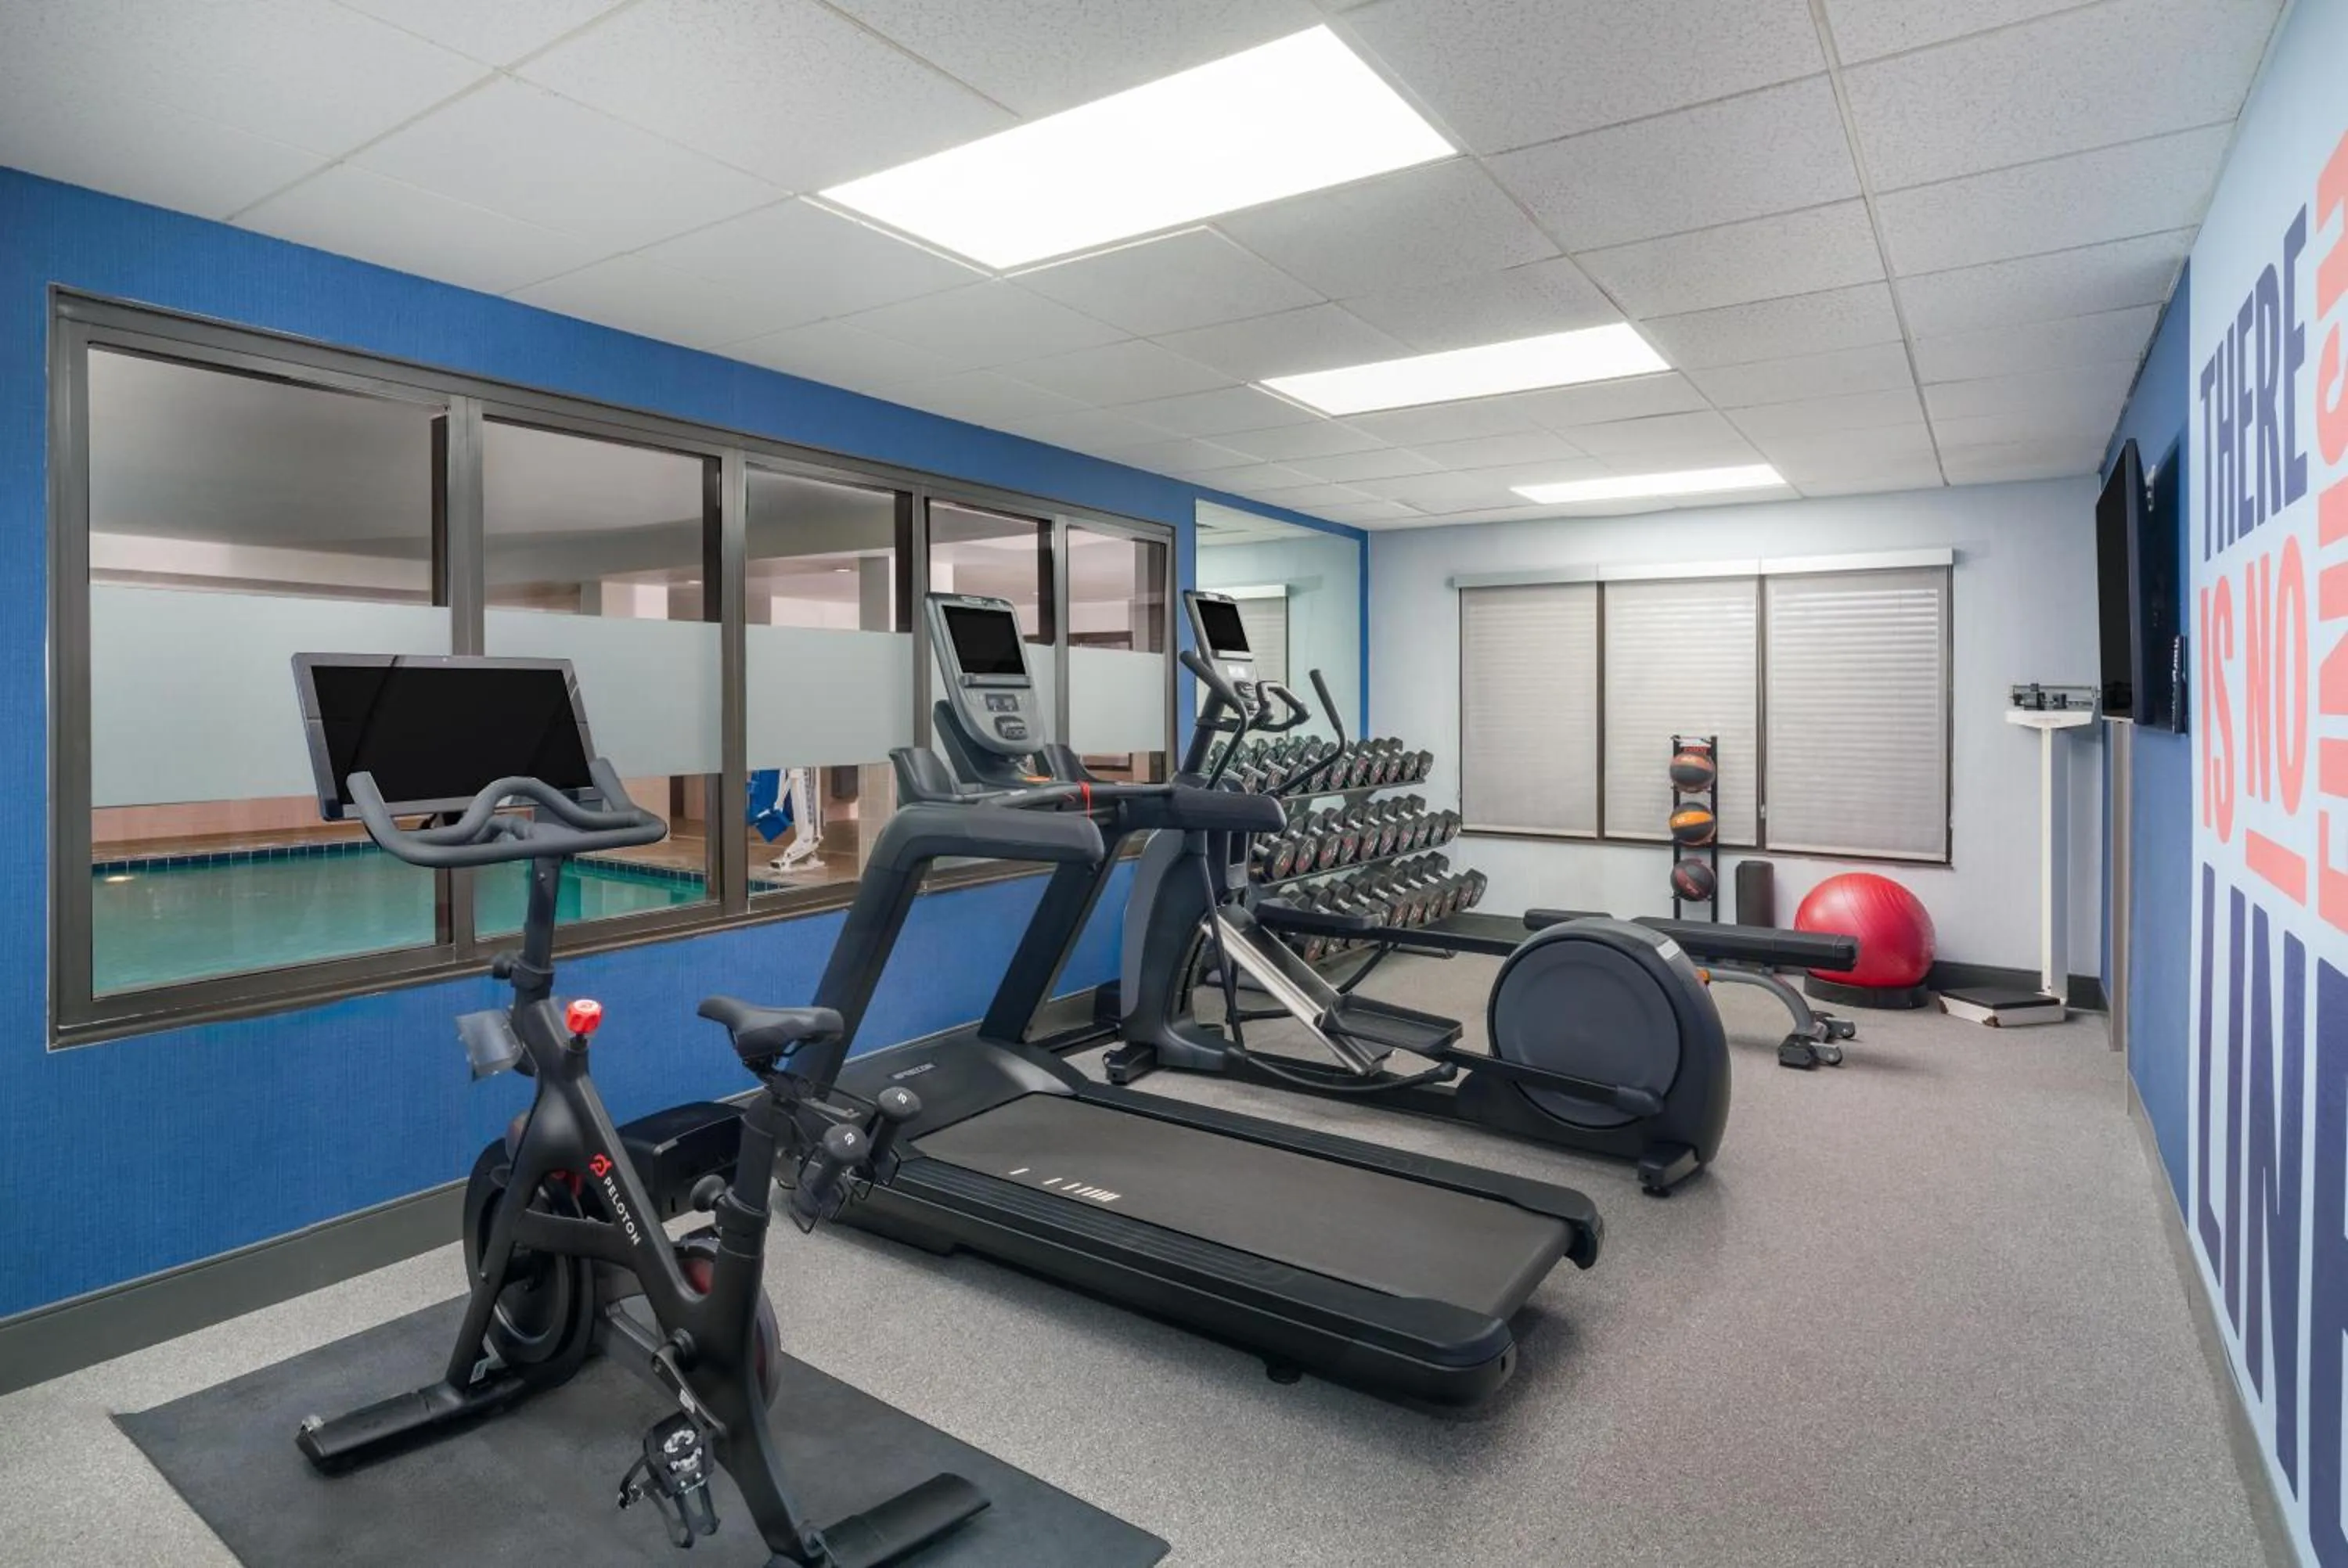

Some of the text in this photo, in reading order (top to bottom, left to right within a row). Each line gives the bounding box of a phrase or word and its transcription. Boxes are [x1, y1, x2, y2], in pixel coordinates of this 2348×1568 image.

[2200, 202, 2308, 563] THERE
[2200, 534, 2308, 844] IS NO
[603, 1176, 641, 1246] PELOTON
